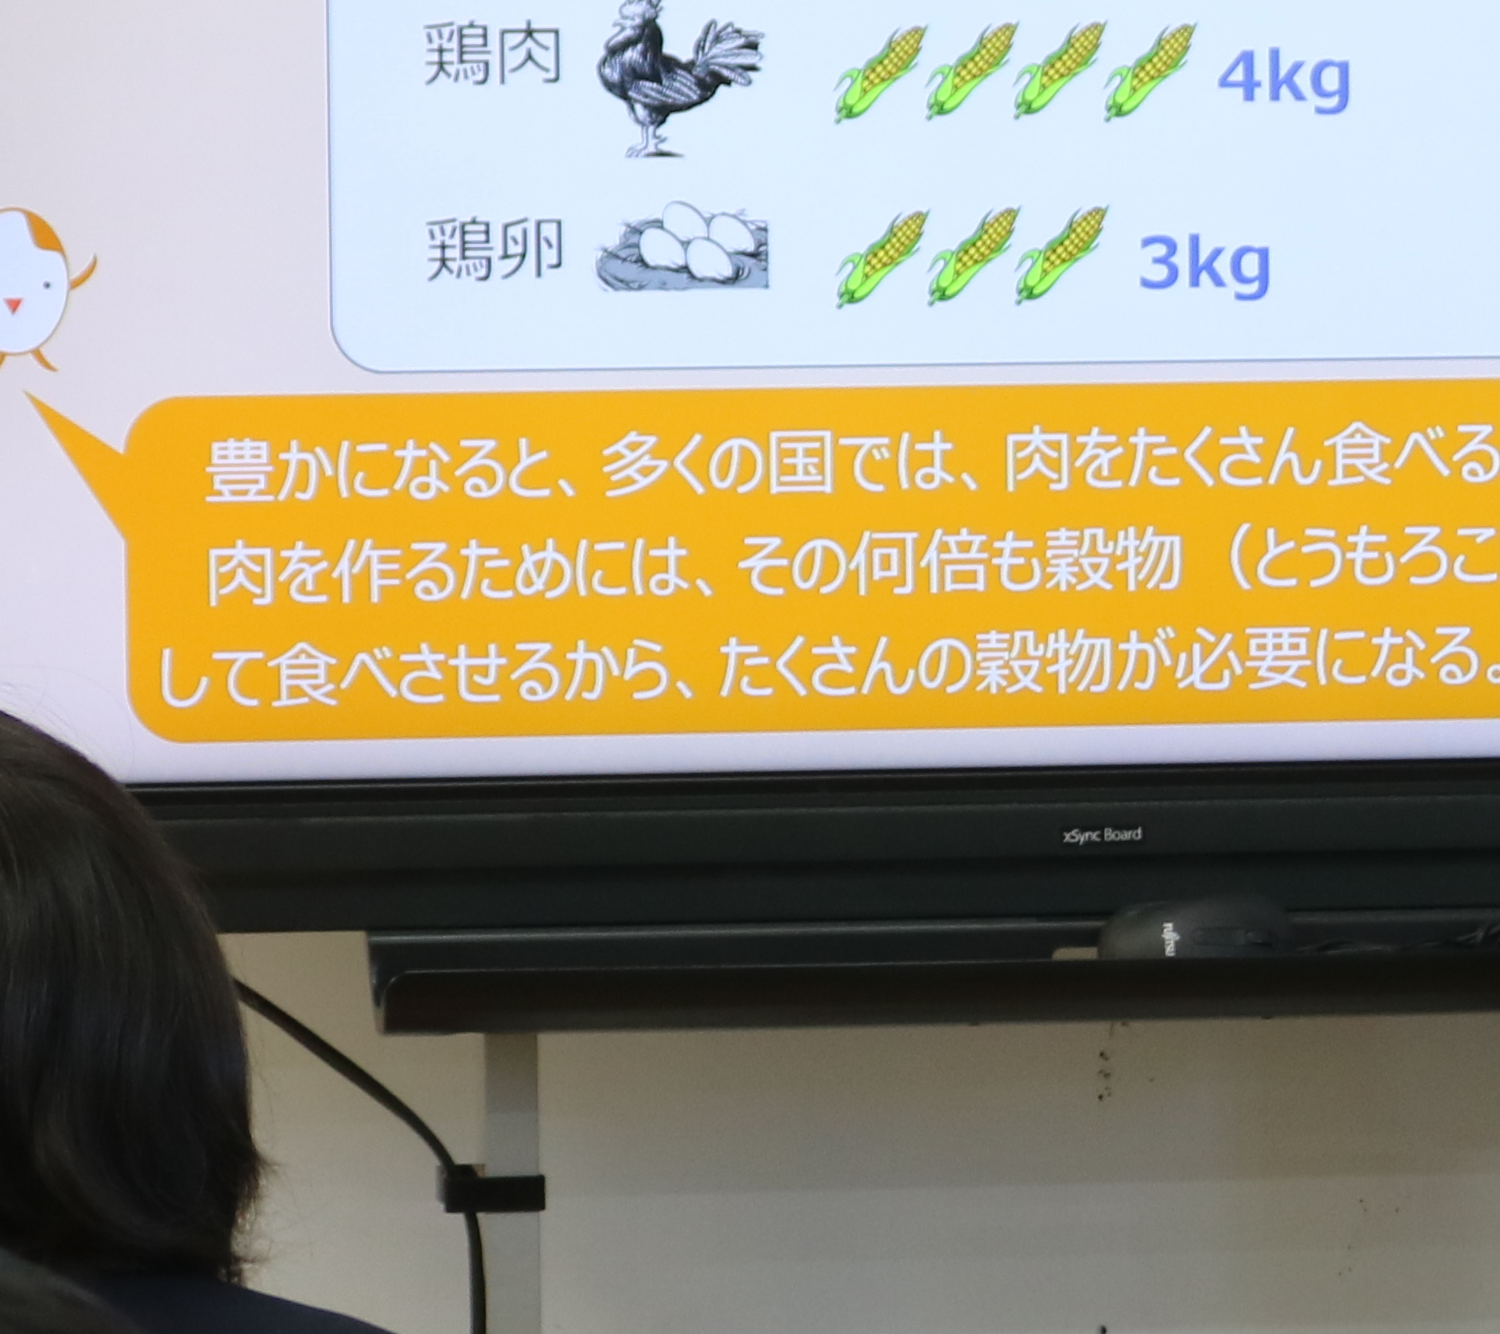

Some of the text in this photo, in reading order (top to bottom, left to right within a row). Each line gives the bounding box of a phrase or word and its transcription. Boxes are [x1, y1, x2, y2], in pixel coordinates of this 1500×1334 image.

[423, 20, 1351, 117] 鶏肉 4kg
[425, 217, 1272, 303] 鶏卵 3kg
[1063, 826, 1142, 845] xSync Board
